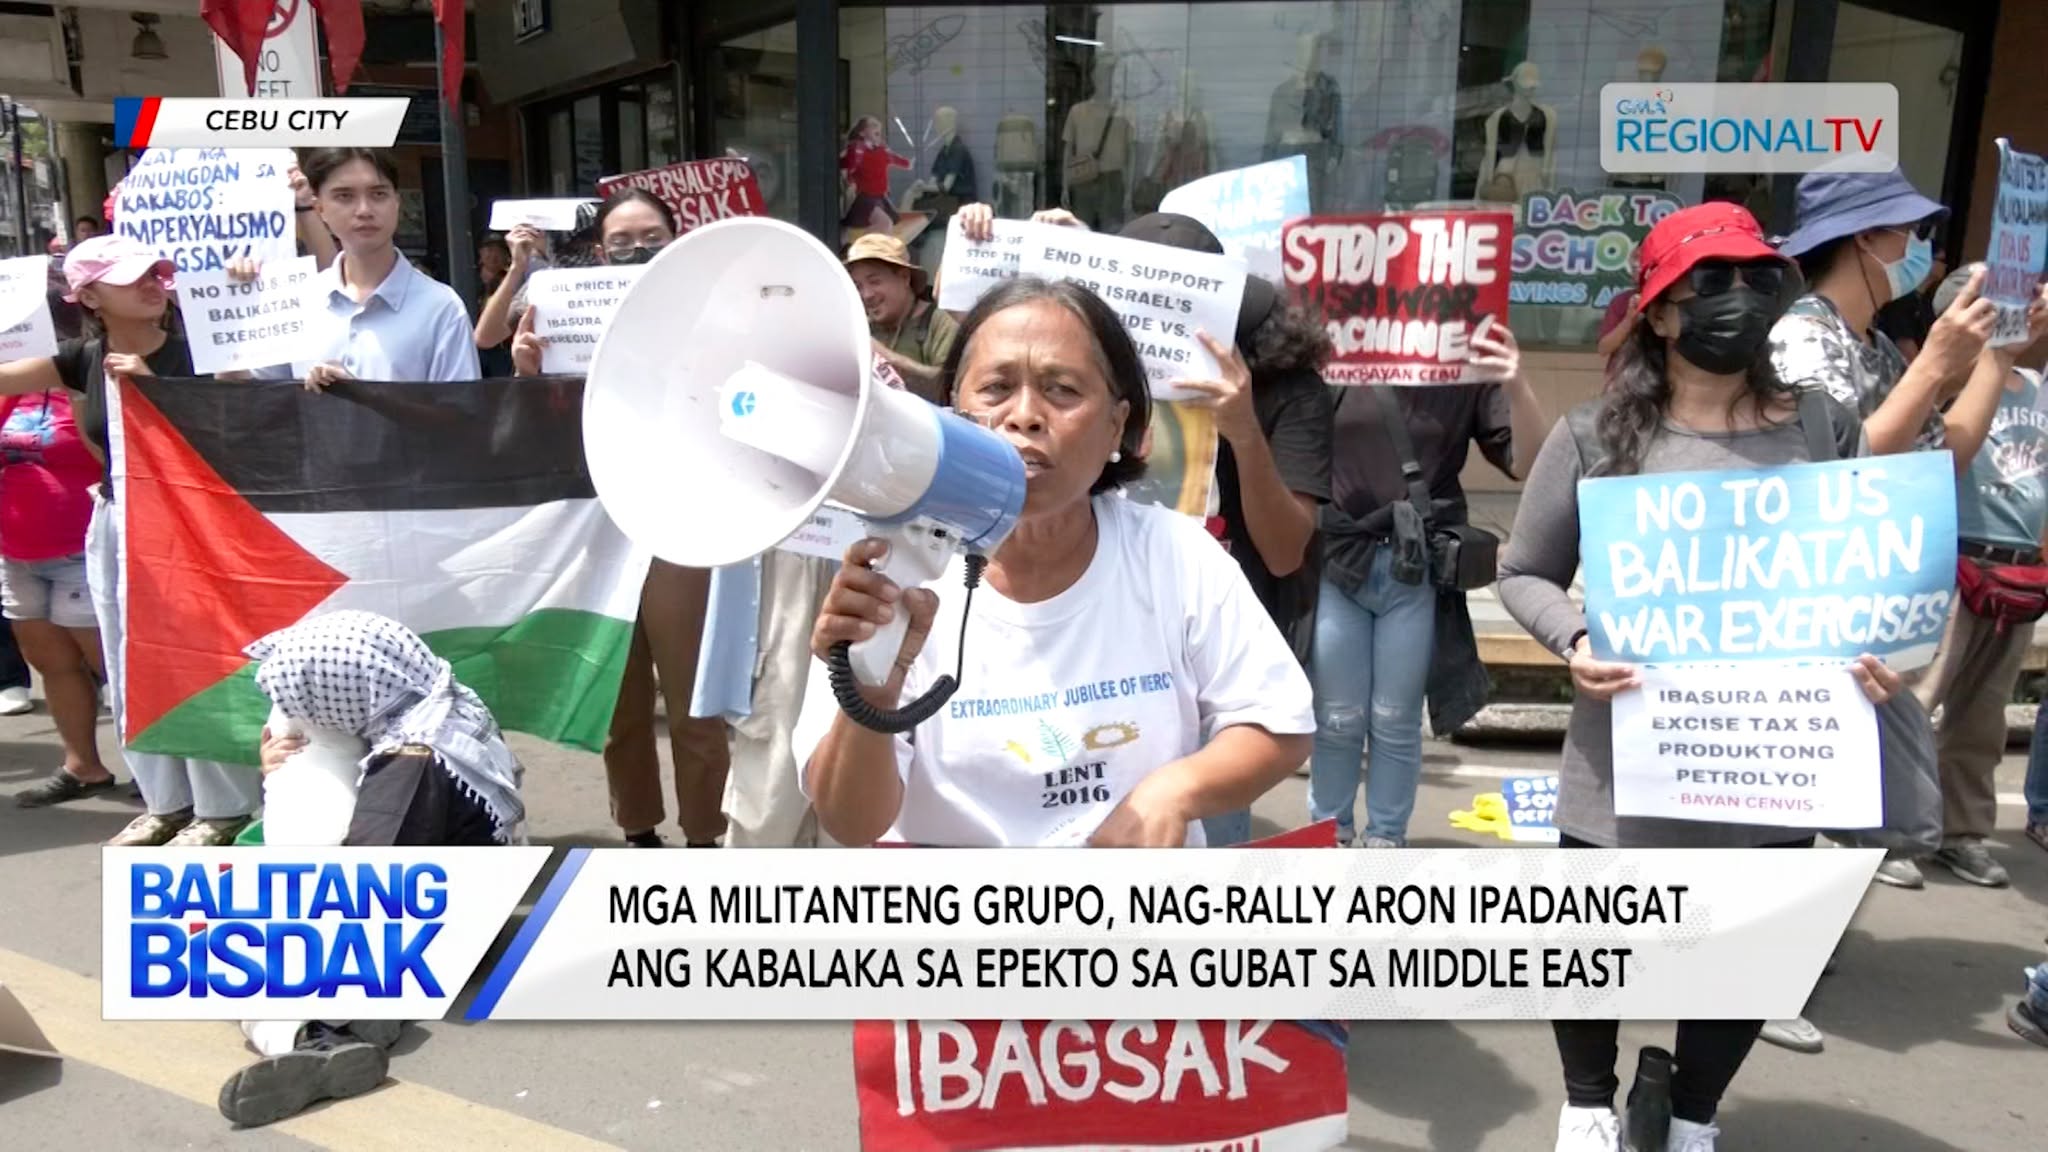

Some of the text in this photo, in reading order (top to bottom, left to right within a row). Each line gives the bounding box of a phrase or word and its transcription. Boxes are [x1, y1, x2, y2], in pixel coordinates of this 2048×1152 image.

[256, 164, 276, 178] SA
[1528, 194, 1625, 231] BACK
[120, 210, 286, 245] IMPERYALISMO
[1409, 218, 1500, 286] THE
[1511, 230, 1640, 274] SCHO
[1043, 248, 1225, 294] END U.S. SUPPORT
[190, 285, 221, 300] NO
[227, 283, 253, 296] TO
[574, 280, 616, 292] PRICE
[208, 298, 301, 323] BALIKATAN
[1105, 285, 1193, 315] ISRAEL'S
[1387, 283, 1487, 325] WAR
[212, 320, 305, 346] EXERCISES!
[1160, 321, 1190, 338] VS.
[1419, 364, 1462, 381] CEBU
[1635, 468, 1889, 535] NO TO US
[1608, 514, 1924, 599] BALIKATAN
[1598, 590, 1950, 657] WAR EXERCISES
[949, 691, 1059, 719] EXTRAORDINARY
[1063, 680, 1118, 707] JUBILEE
[1119, 676, 1138, 696] OF
[1659, 688, 1832, 706] IBASURA ANG
[1651, 715, 1841, 733] EXCISE TAX SA
[1658, 743, 1835, 761] PRODUKTONG
[1044, 761, 1108, 789] LENT
[1676, 768, 1817, 788] PETROLYO!
[1041, 784, 1111, 809] 2016
[1680, 792, 1815, 812] BAYAN CENVIS
